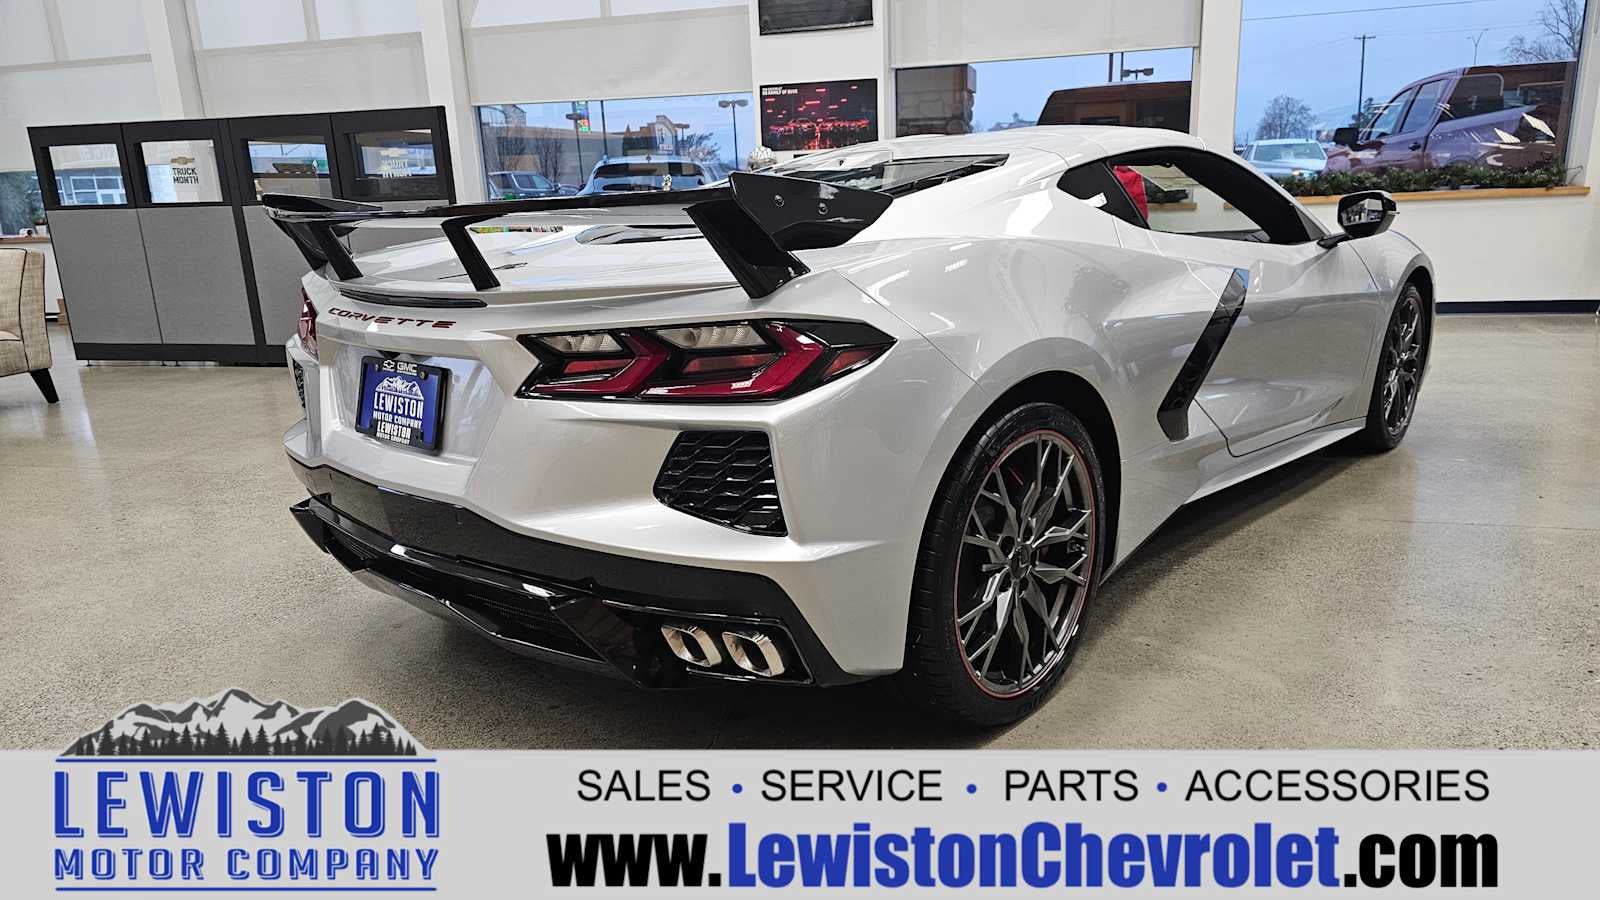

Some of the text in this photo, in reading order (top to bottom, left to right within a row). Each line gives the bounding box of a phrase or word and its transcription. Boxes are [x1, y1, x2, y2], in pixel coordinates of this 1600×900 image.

[172, 168, 197, 176] TRUCK
[173, 176, 199, 184] MONTH
[328, 307, 456, 329] CORVETTE
[397, 362, 418, 373] GMC
[373, 391, 424, 419] LEWISTON
[373, 410, 422, 429] MOTOR COMPANY
[376, 421, 412, 439] LEWISTON
